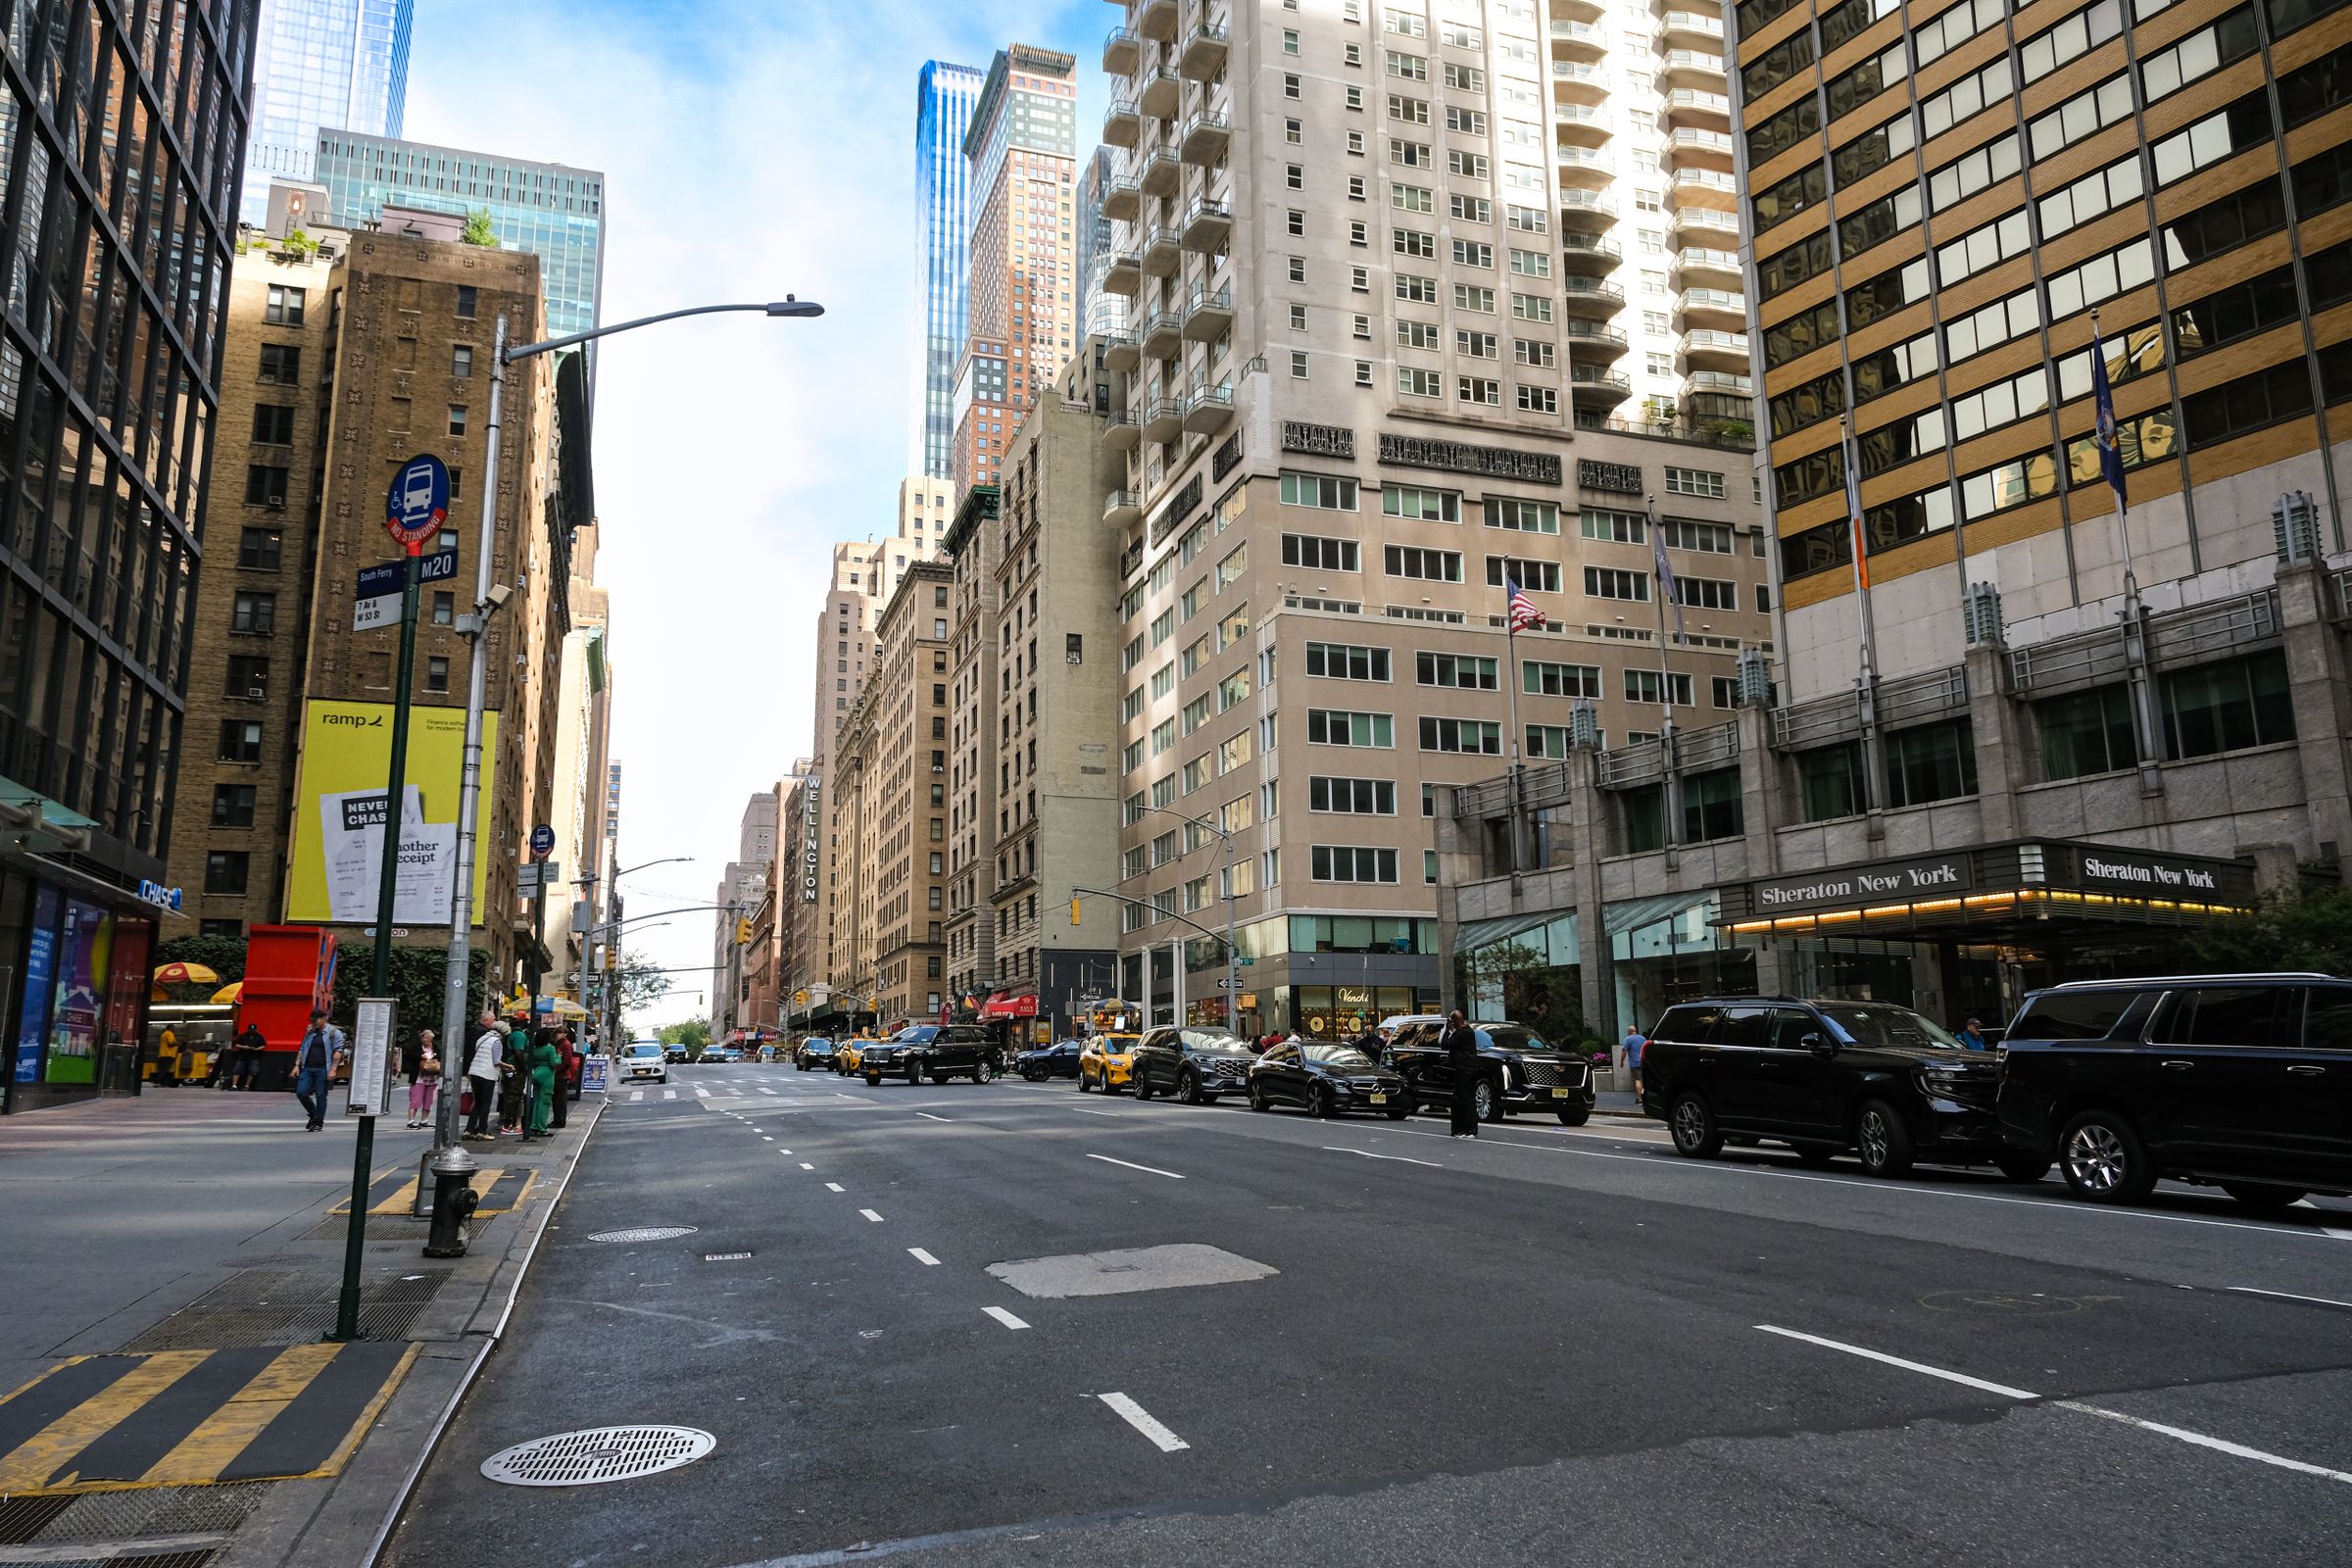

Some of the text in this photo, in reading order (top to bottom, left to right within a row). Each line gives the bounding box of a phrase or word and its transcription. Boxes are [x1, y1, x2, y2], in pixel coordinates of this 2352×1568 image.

[391, 515, 440, 542] NO STANDING
[421, 554, 452, 579] M20
[360, 568, 393, 582] South Ferry
[363, 601, 370, 610] Av
[371, 599, 377, 608] &
[357, 610, 380, 622] W 53 St
[322, 713, 367, 729] ramp
[348, 812, 387, 825] CHAS
[398, 840, 439, 853] nother
[806, 778, 821, 900] WELLINGTON
[397, 852, 436, 865] eceipt
[2084, 858, 2216, 889] Sheraton New York
[1761, 864, 1959, 906] Sheraton New York
[142, 879, 173, 909] CHASE
[1338, 988, 1370, 1003] Venchi
